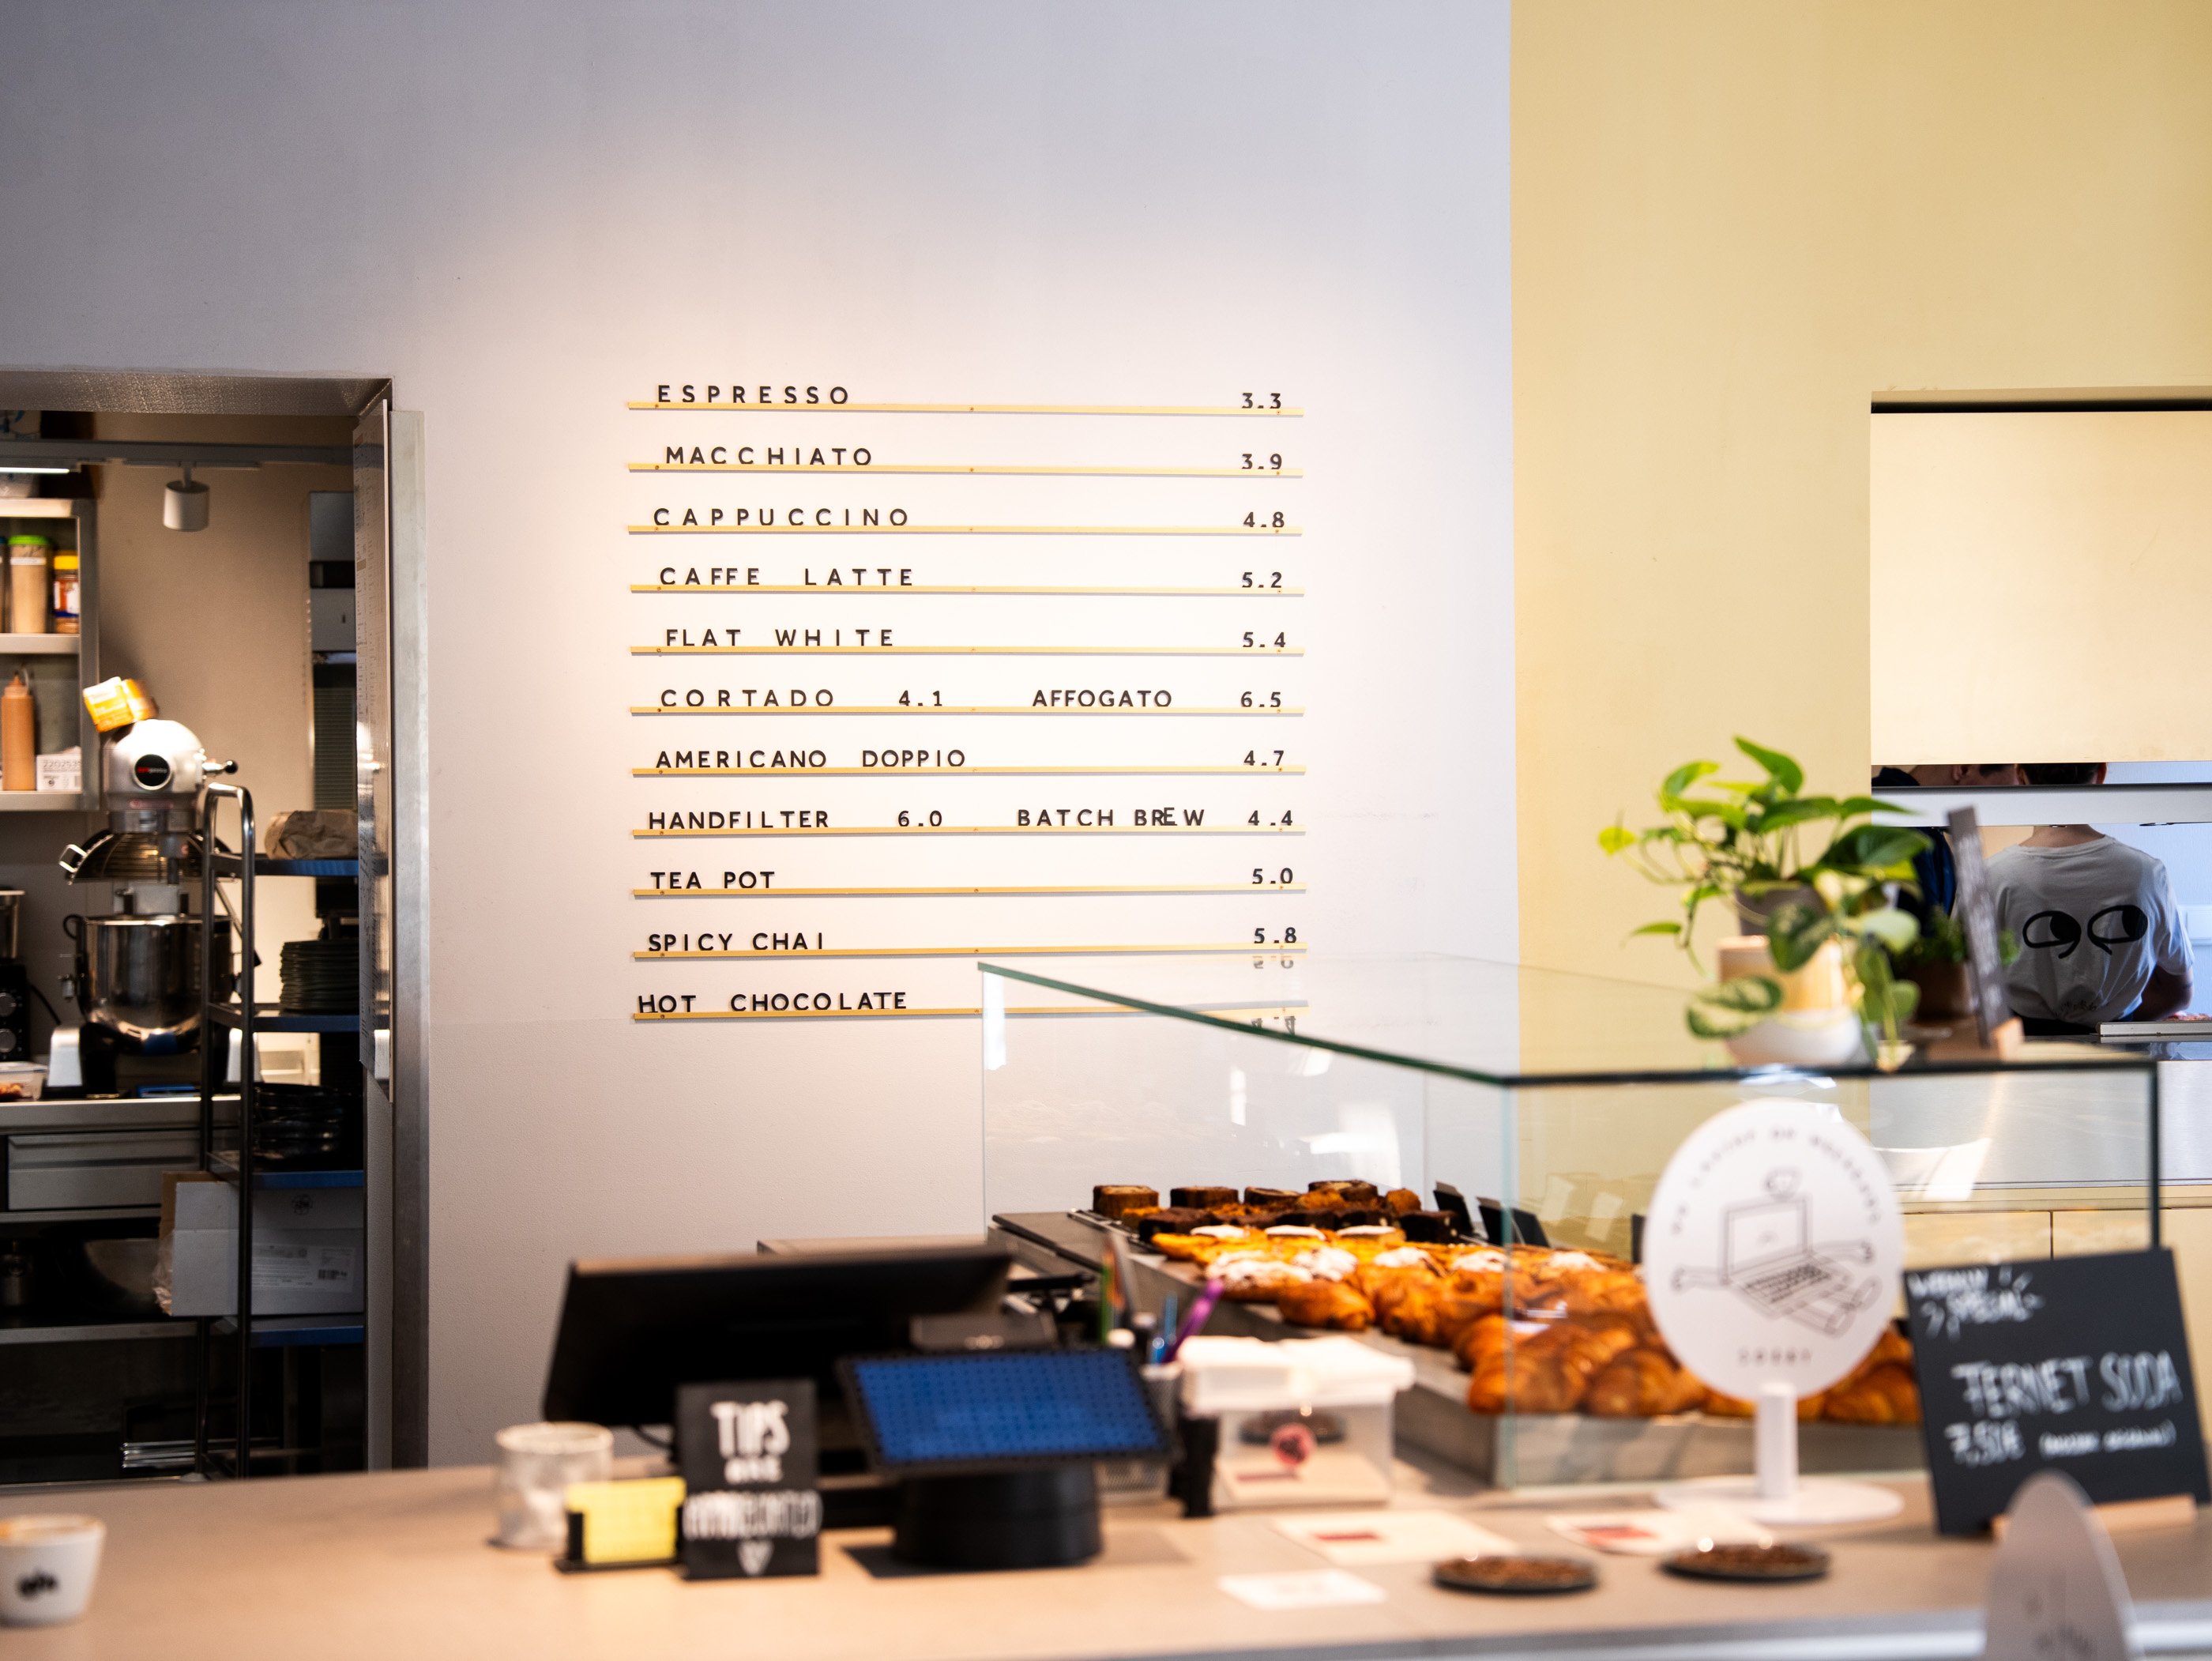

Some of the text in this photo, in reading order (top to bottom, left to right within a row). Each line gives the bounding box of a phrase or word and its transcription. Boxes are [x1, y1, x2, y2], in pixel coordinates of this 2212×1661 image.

[658, 385, 1281, 409] ESPRESSO 3.3
[666, 446, 1282, 470] MACCHIATO 3.9
[653, 507, 1285, 528] CAPPUCCINO 4.8
[660, 567, 1282, 588] CAFFE LATTE 5.2
[667, 628, 1286, 648] FLAT WHITE 5.4
[660, 689, 1281, 707] CORTADO 4.1 AFFOGATO 6.5
[656, 749, 1285, 768] AMERICANO DOPPIO 4.7
[649, 807, 1293, 830] HANDFILTER 6.0 BATCH BREW 4.4
[650, 868, 1293, 890] TEA POT 5.0
[648, 927, 1297, 952] SPICY CHAI 5.8
[638, 992, 907, 1014] HOT CHOCOLATE
[710, 1400, 790, 1459] TIPS
